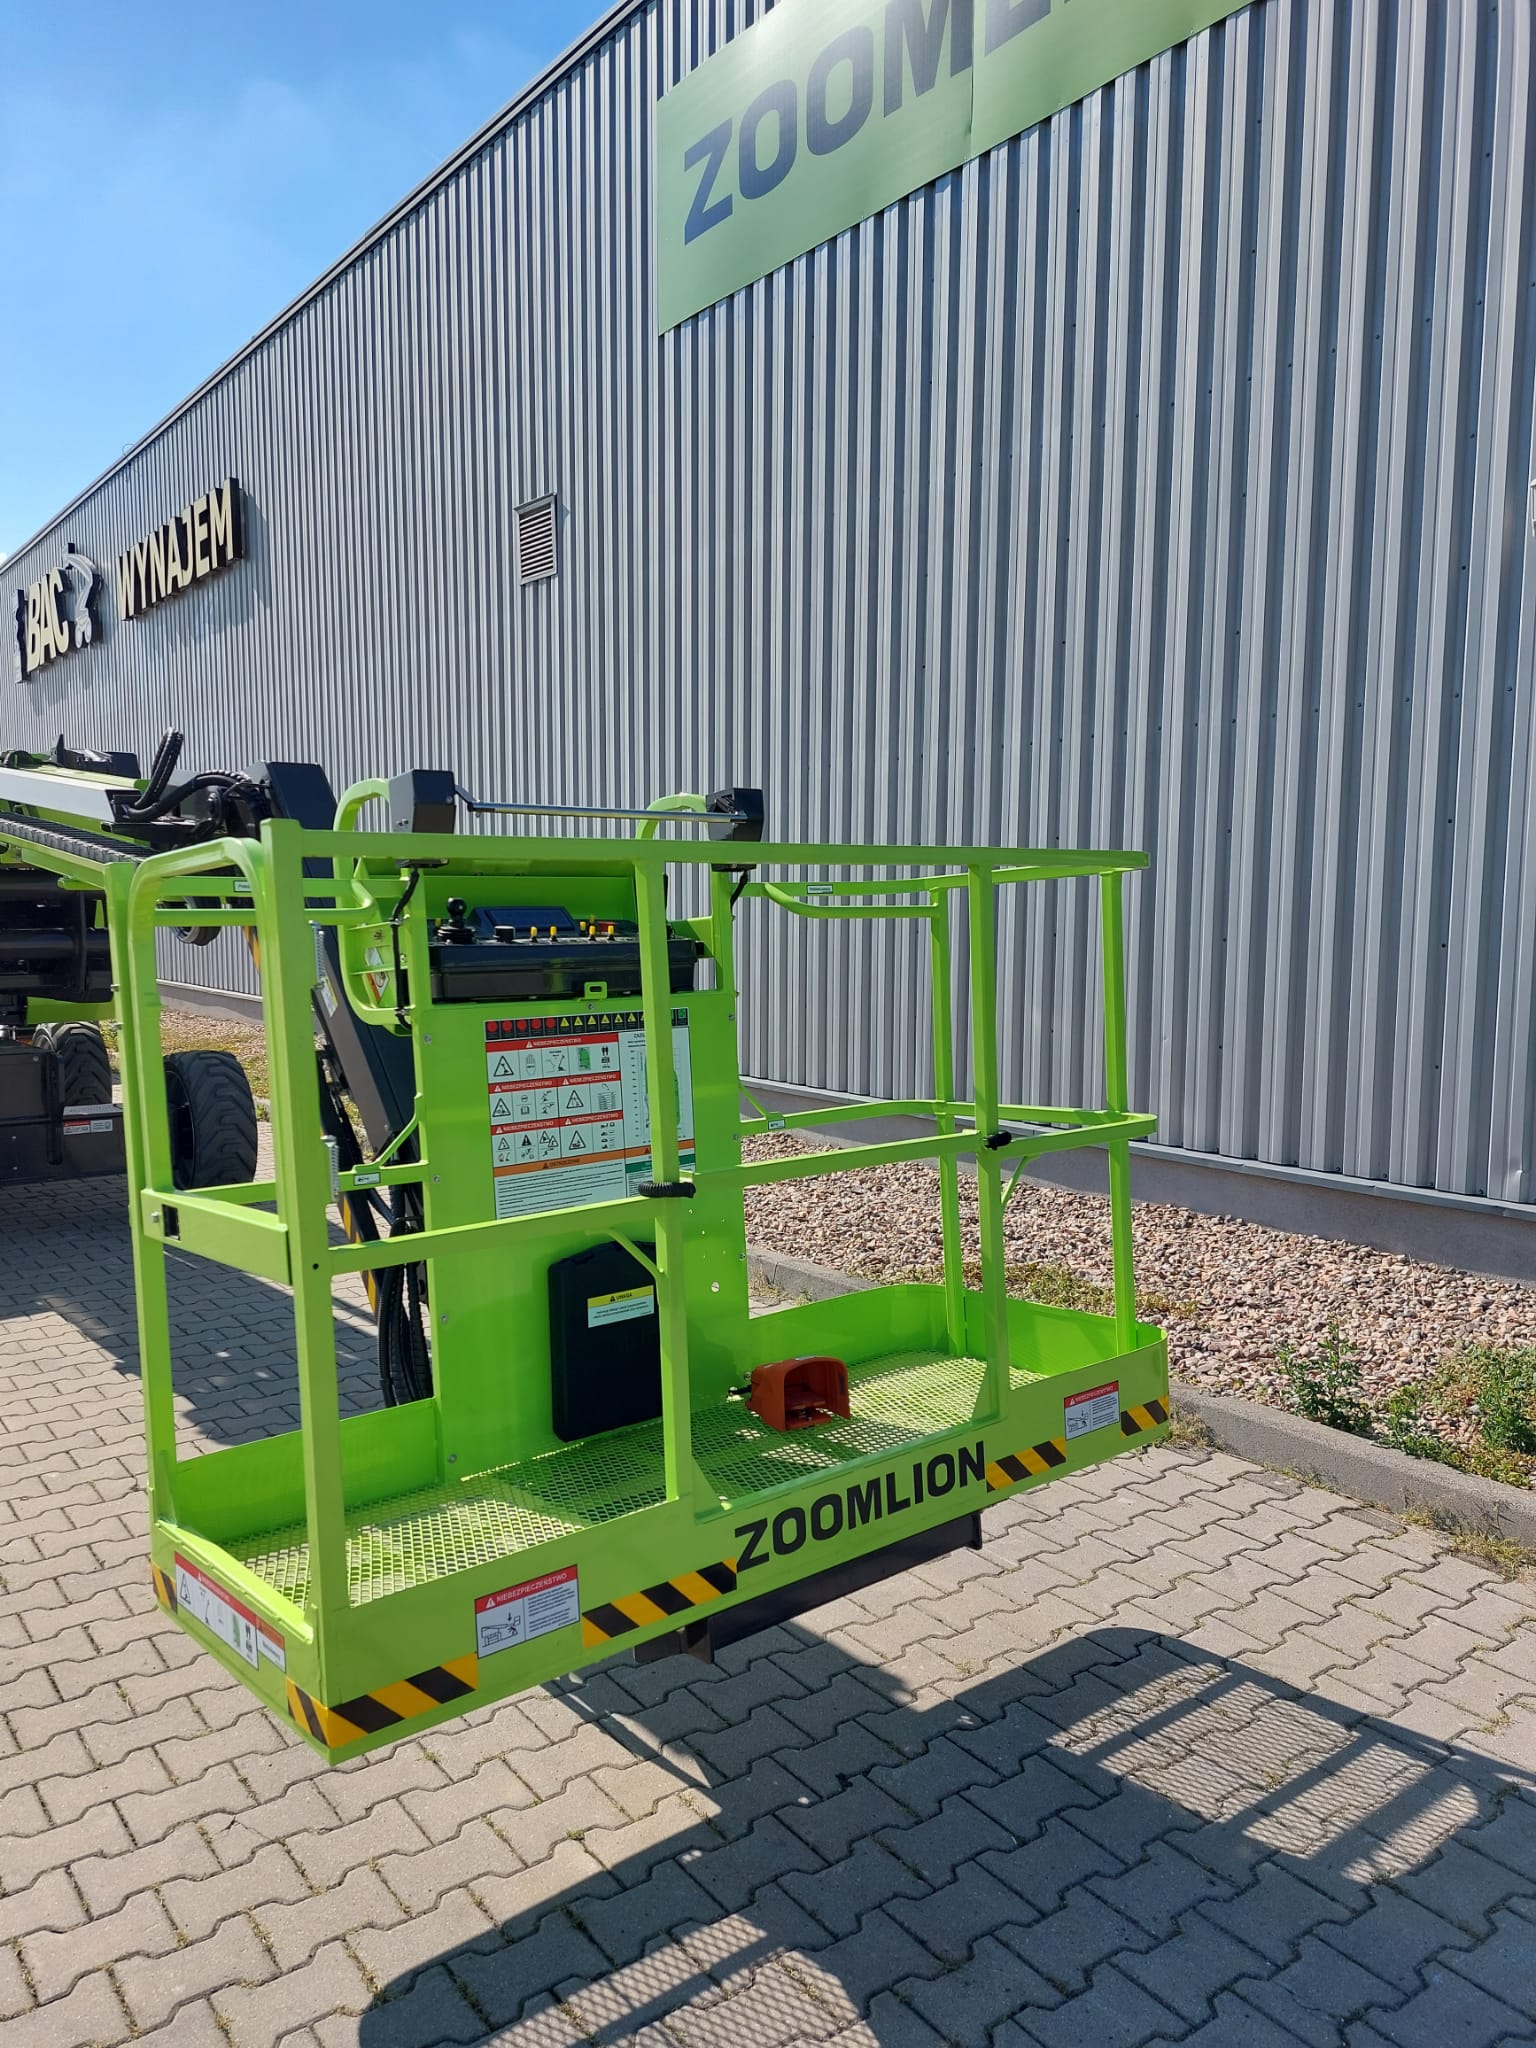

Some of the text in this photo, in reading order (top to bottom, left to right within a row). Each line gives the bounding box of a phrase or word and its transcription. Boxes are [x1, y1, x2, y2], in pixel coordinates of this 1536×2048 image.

[116, 477, 236, 621] WYNAJEM
[26, 566, 70, 673] BAC
[734, 1440, 986, 1573] ZOOMLION
